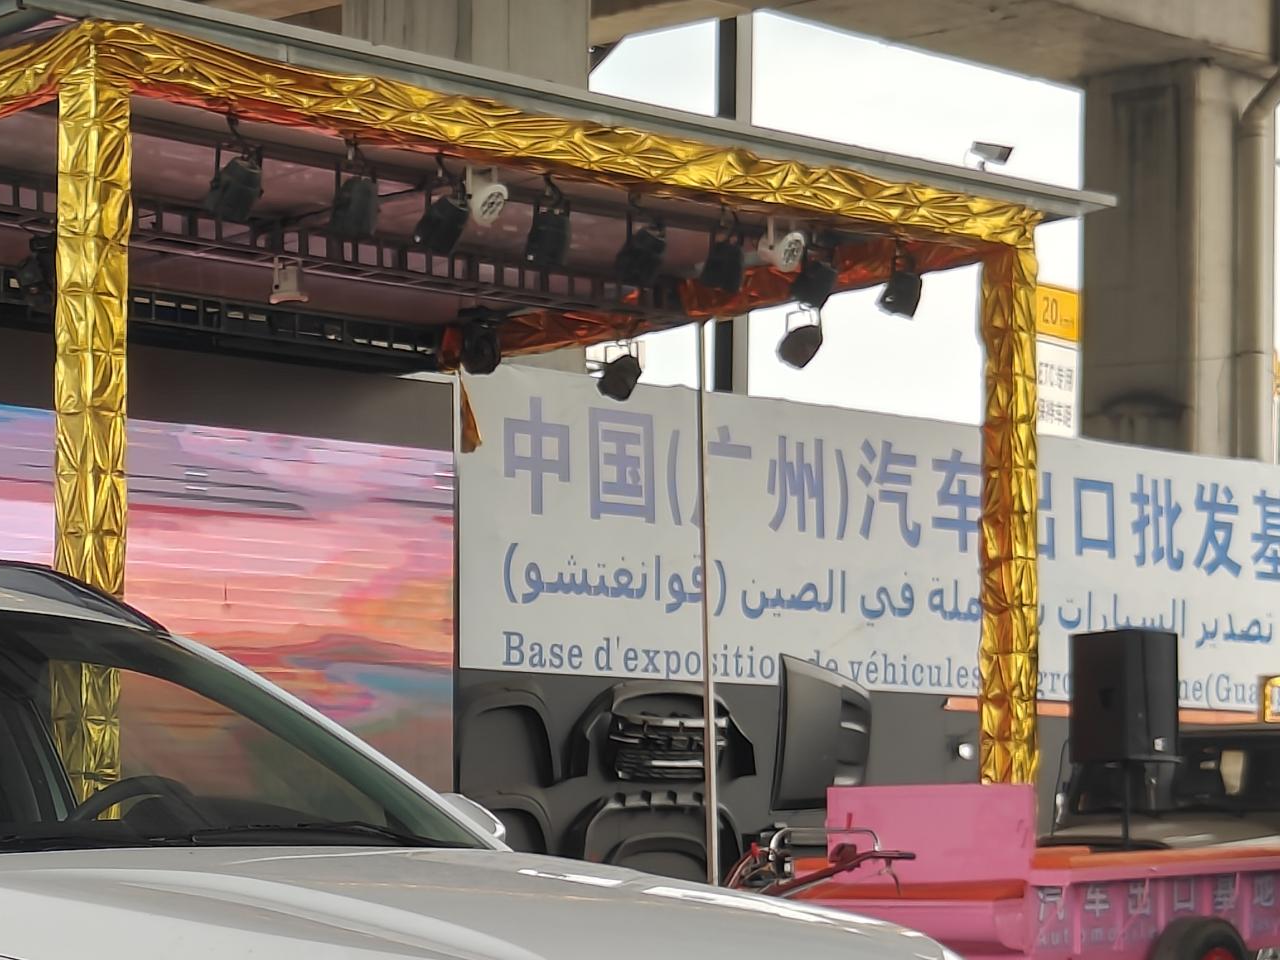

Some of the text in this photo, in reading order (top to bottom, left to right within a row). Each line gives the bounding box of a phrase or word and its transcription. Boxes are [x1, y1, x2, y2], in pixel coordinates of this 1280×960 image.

[1042, 296, 1058, 325] 20
[741, 568, 846, 620] الصين
[860, 571, 915, 627] في
[502, 631, 583, 669] Base
